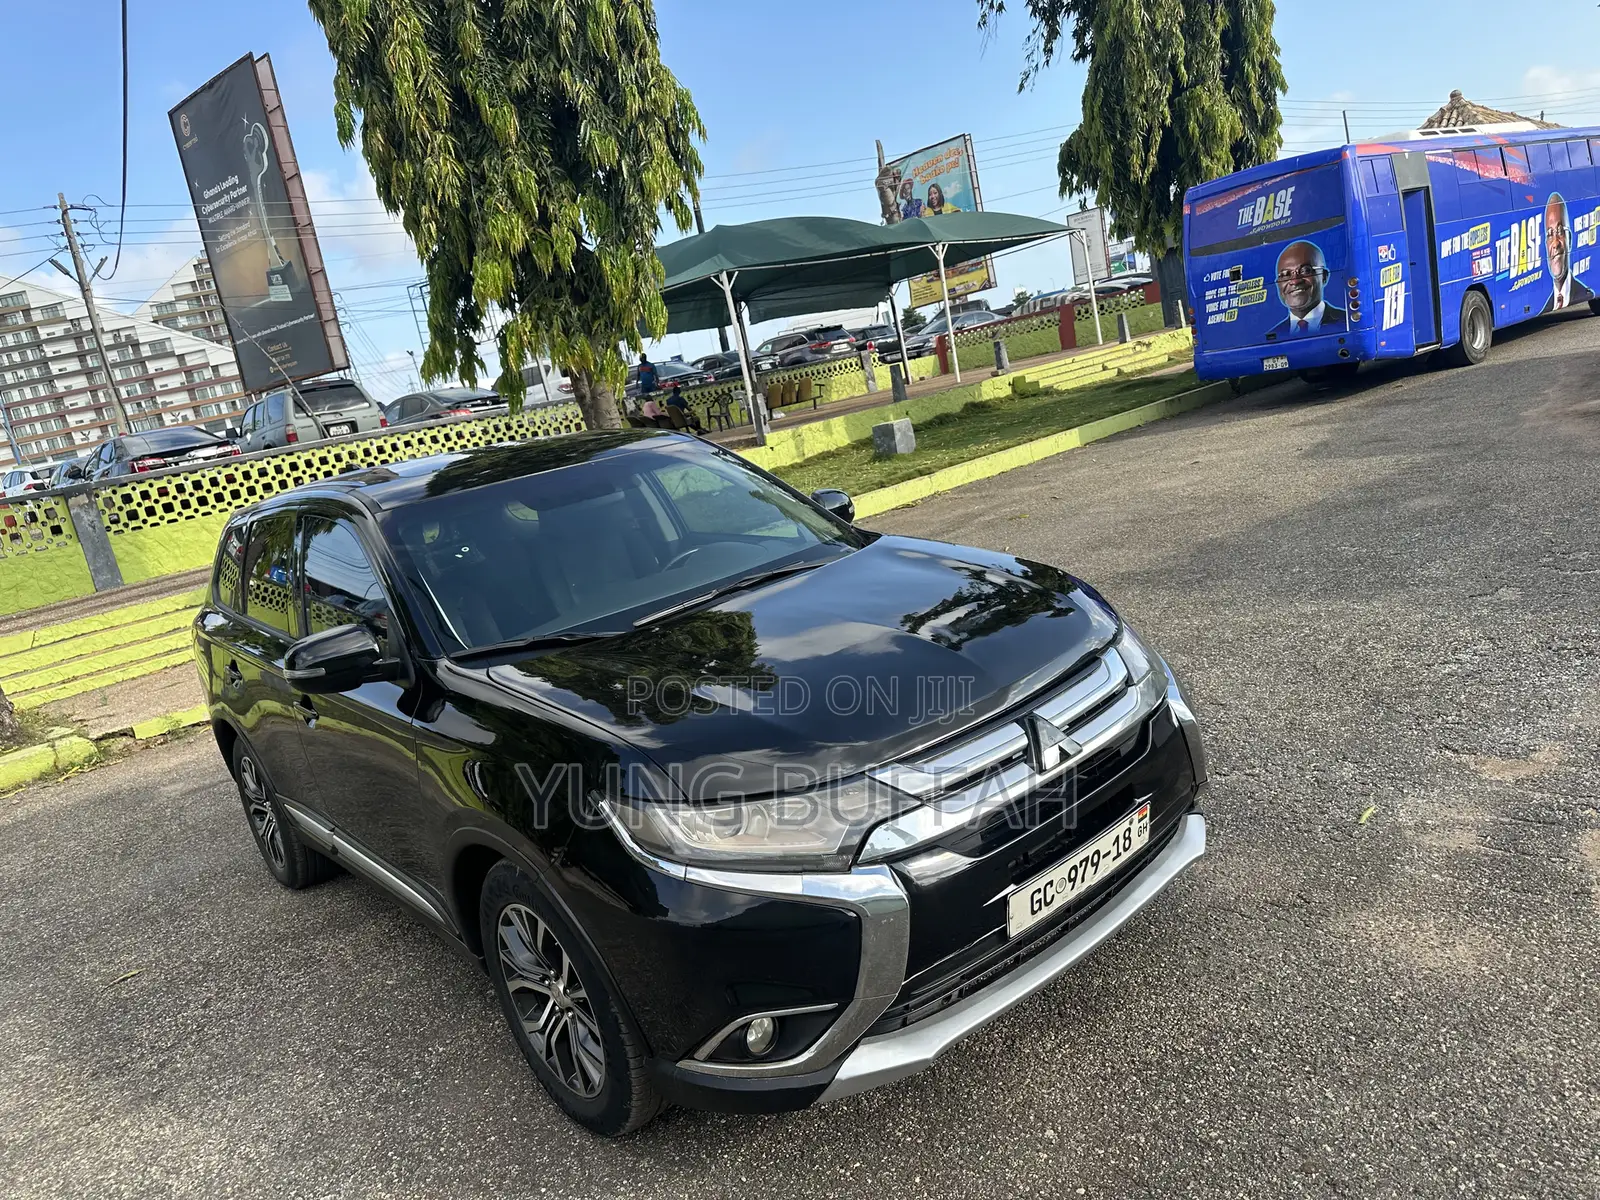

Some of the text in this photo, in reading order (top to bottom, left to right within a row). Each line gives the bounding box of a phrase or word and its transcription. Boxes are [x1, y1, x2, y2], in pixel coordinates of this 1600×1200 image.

[203, 175, 239, 199] Ghana's Leading
[201, 185, 247, 215] Cybersecurity Partner
[1238, 185, 1296, 227] THE BASE
[1452, 235, 1461, 254] FOR
[1495, 236, 1510, 274] THE
[1509, 213, 1542, 279] BASE
[1210, 270, 1222, 282] VOTE
[1382, 267, 1392, 285] VOTE
[1218, 286, 1227, 297] FOR
[1228, 284, 1237, 295] THE
[1206, 301, 1219, 313] VOICE
[1220, 299, 1229, 310] FOR
[1230, 297, 1239, 308] THE
[1382, 281, 1405, 331] KEN
[267, 343, 281, 352] Contact
[1137, 822, 1148, 838] GH
[1030, 826, 1132, 916] GC 979-18
